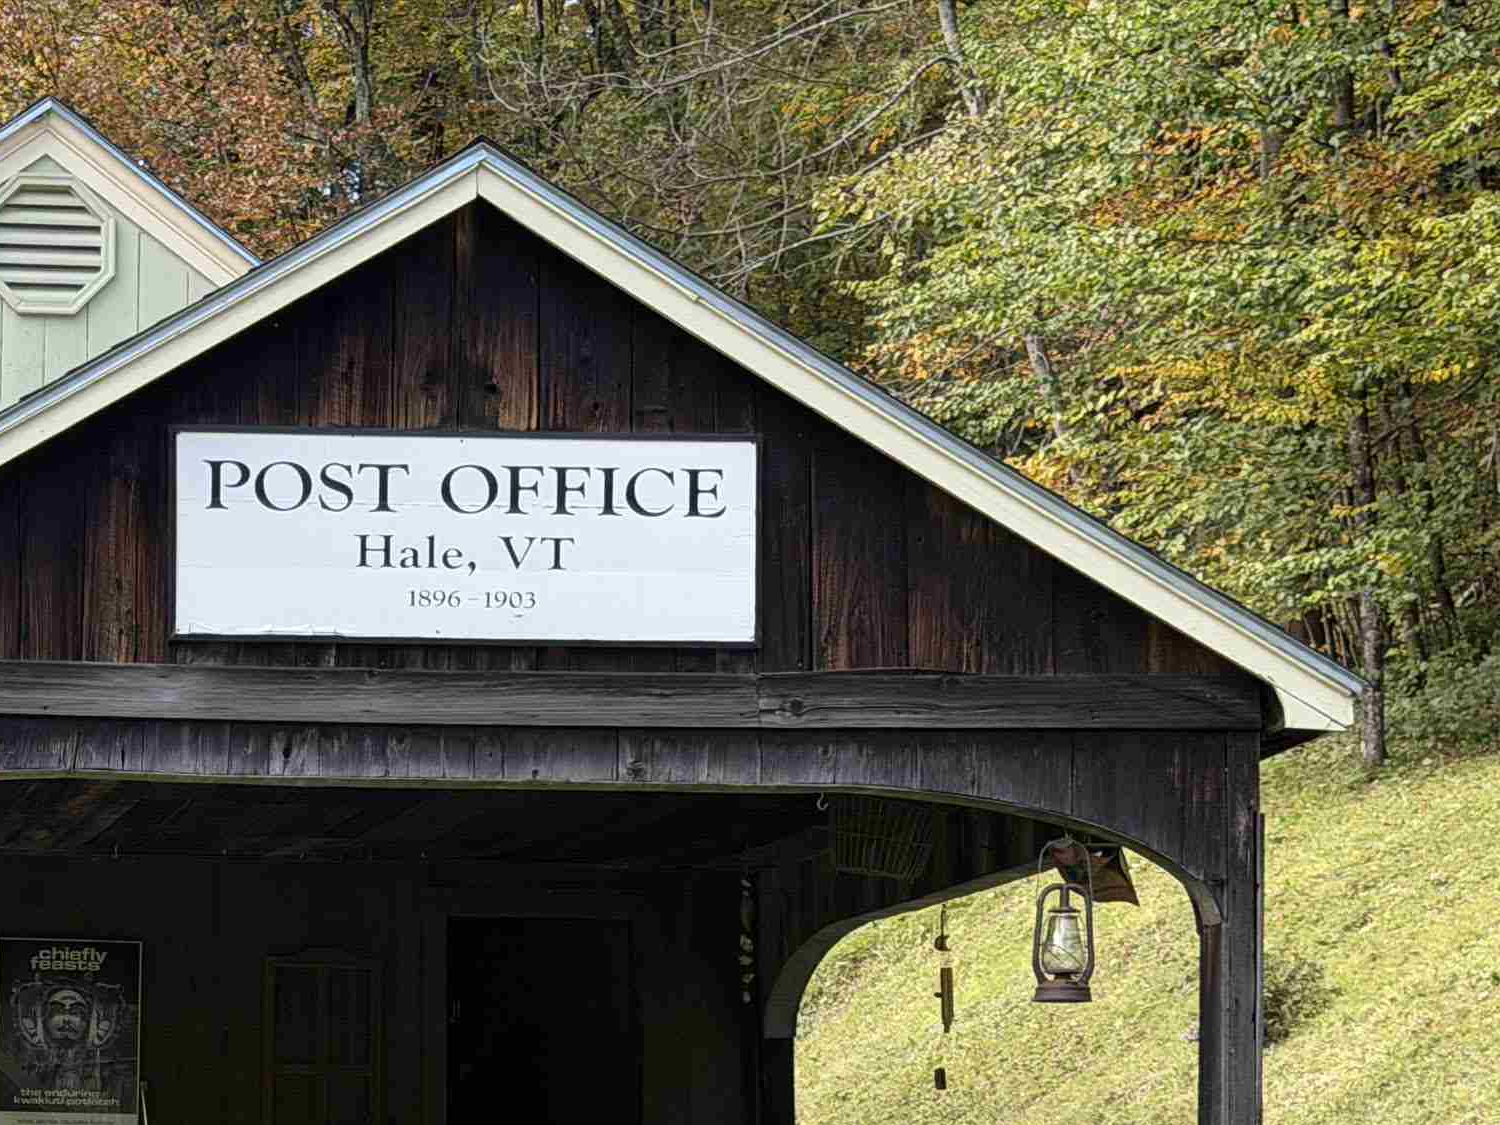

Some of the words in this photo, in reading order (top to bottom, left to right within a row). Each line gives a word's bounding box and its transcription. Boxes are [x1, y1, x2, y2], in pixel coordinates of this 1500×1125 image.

[202, 458, 410, 514] POST
[440, 463, 728, 519] OFFICE
[354, 532, 478, 576] Hale,
[497, 535, 576, 572] VT
[29, 955, 101, 972] feasts
[38, 946, 109, 964] chiefly
[19, 1087, 42, 1097] the
[43, 1087, 102, 1099] enduring
